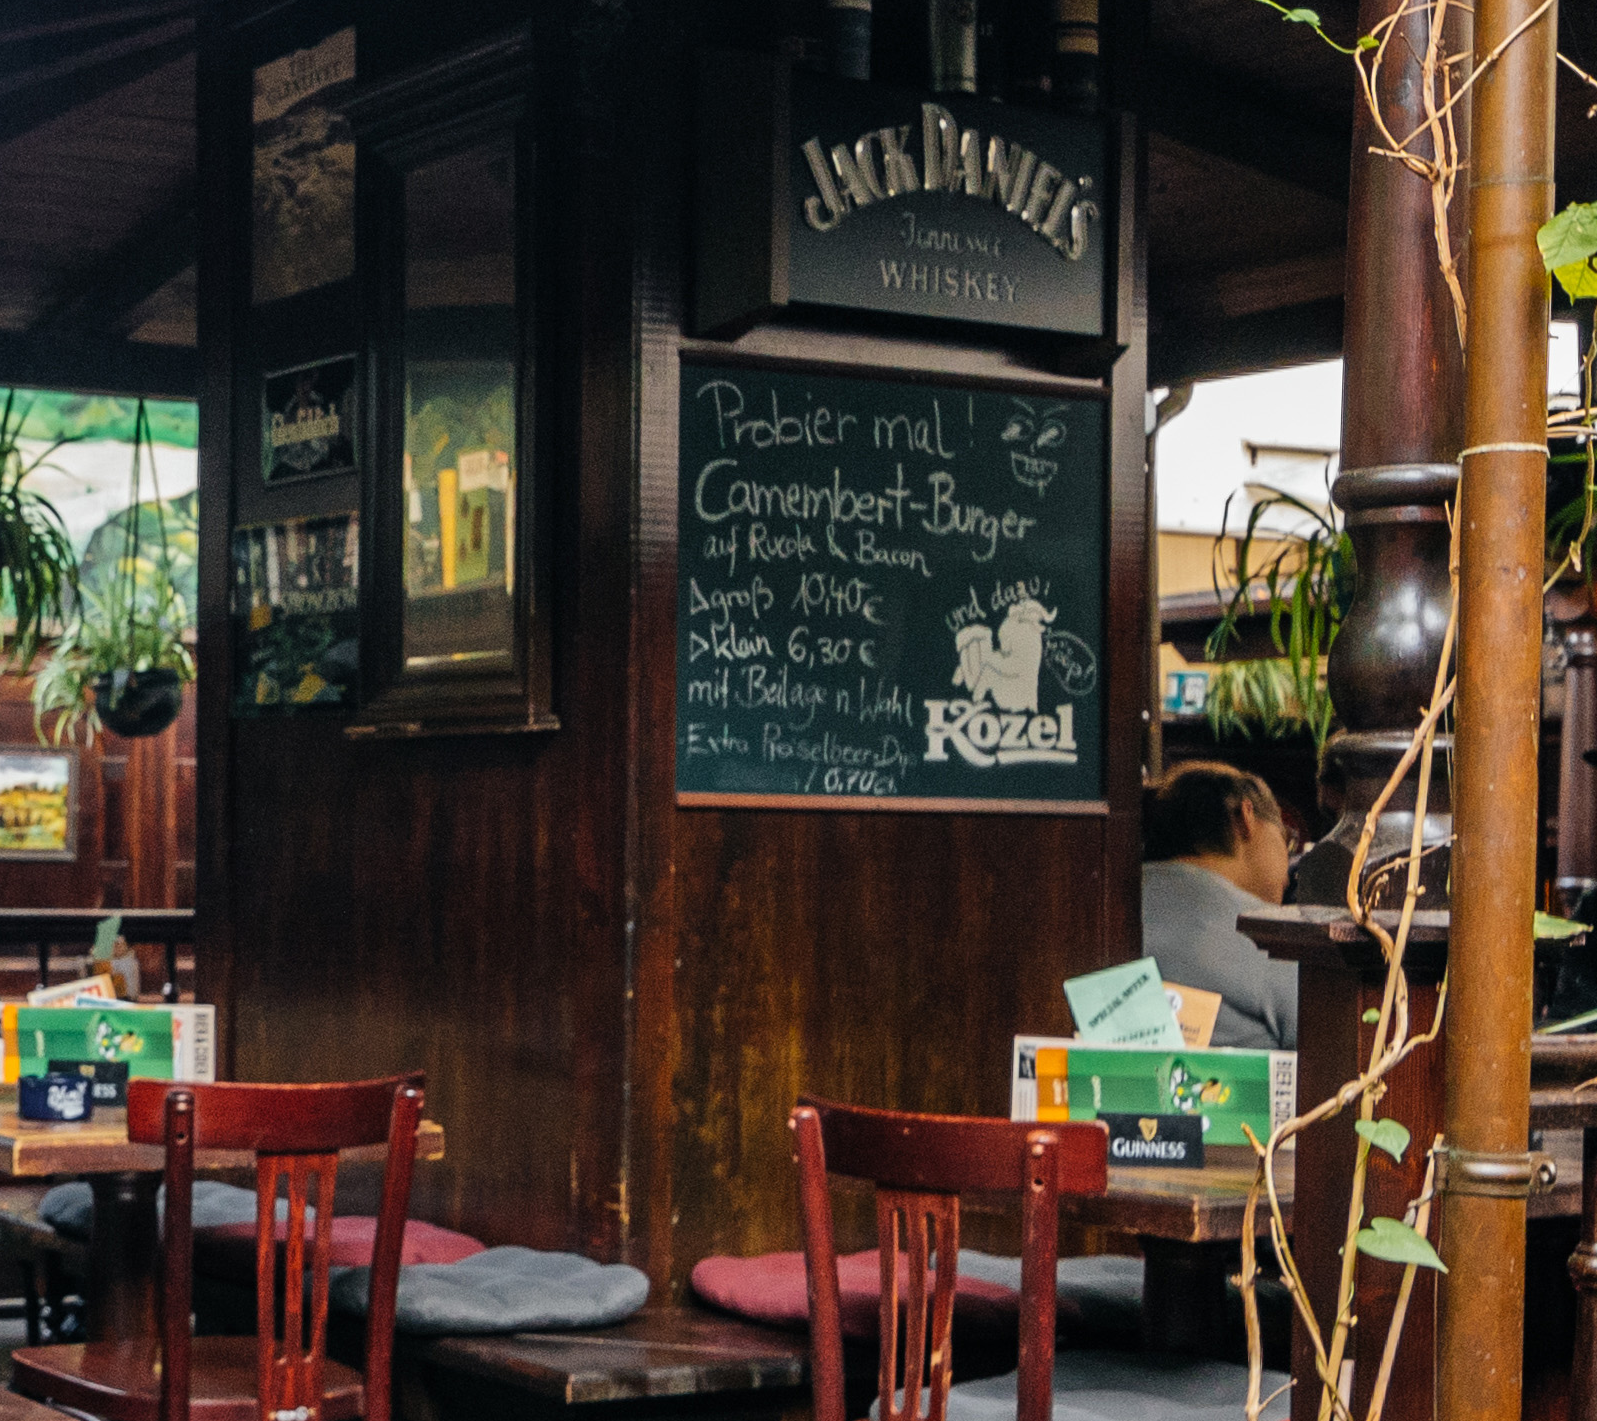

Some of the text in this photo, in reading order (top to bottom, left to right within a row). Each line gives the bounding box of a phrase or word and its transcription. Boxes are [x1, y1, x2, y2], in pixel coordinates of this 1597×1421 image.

[801, 102, 1100, 261] JACK DANIEL'S
[878, 259, 1020, 304] WHISKEY
[696, 379, 858, 450] Probier
[695, 458, 1037, 564] Camembert-Burger
[702, 527, 741, 577] auf
[748, 523, 817, 563] Rucola
[854, 530, 934, 578] Bacon
[709, 576, 775, 628] groß
[944, 584, 988, 634] und
[710, 618, 775, 662] klein
[687, 665, 732, 711] mit
[736, 663, 830, 732] Beilage
[859, 676, 915, 729] Wahl
[685, 721, 751, 760] Extra
[923, 699, 1078, 768] Kozel
[1112, 1136, 1187, 1160] GUINNESS
